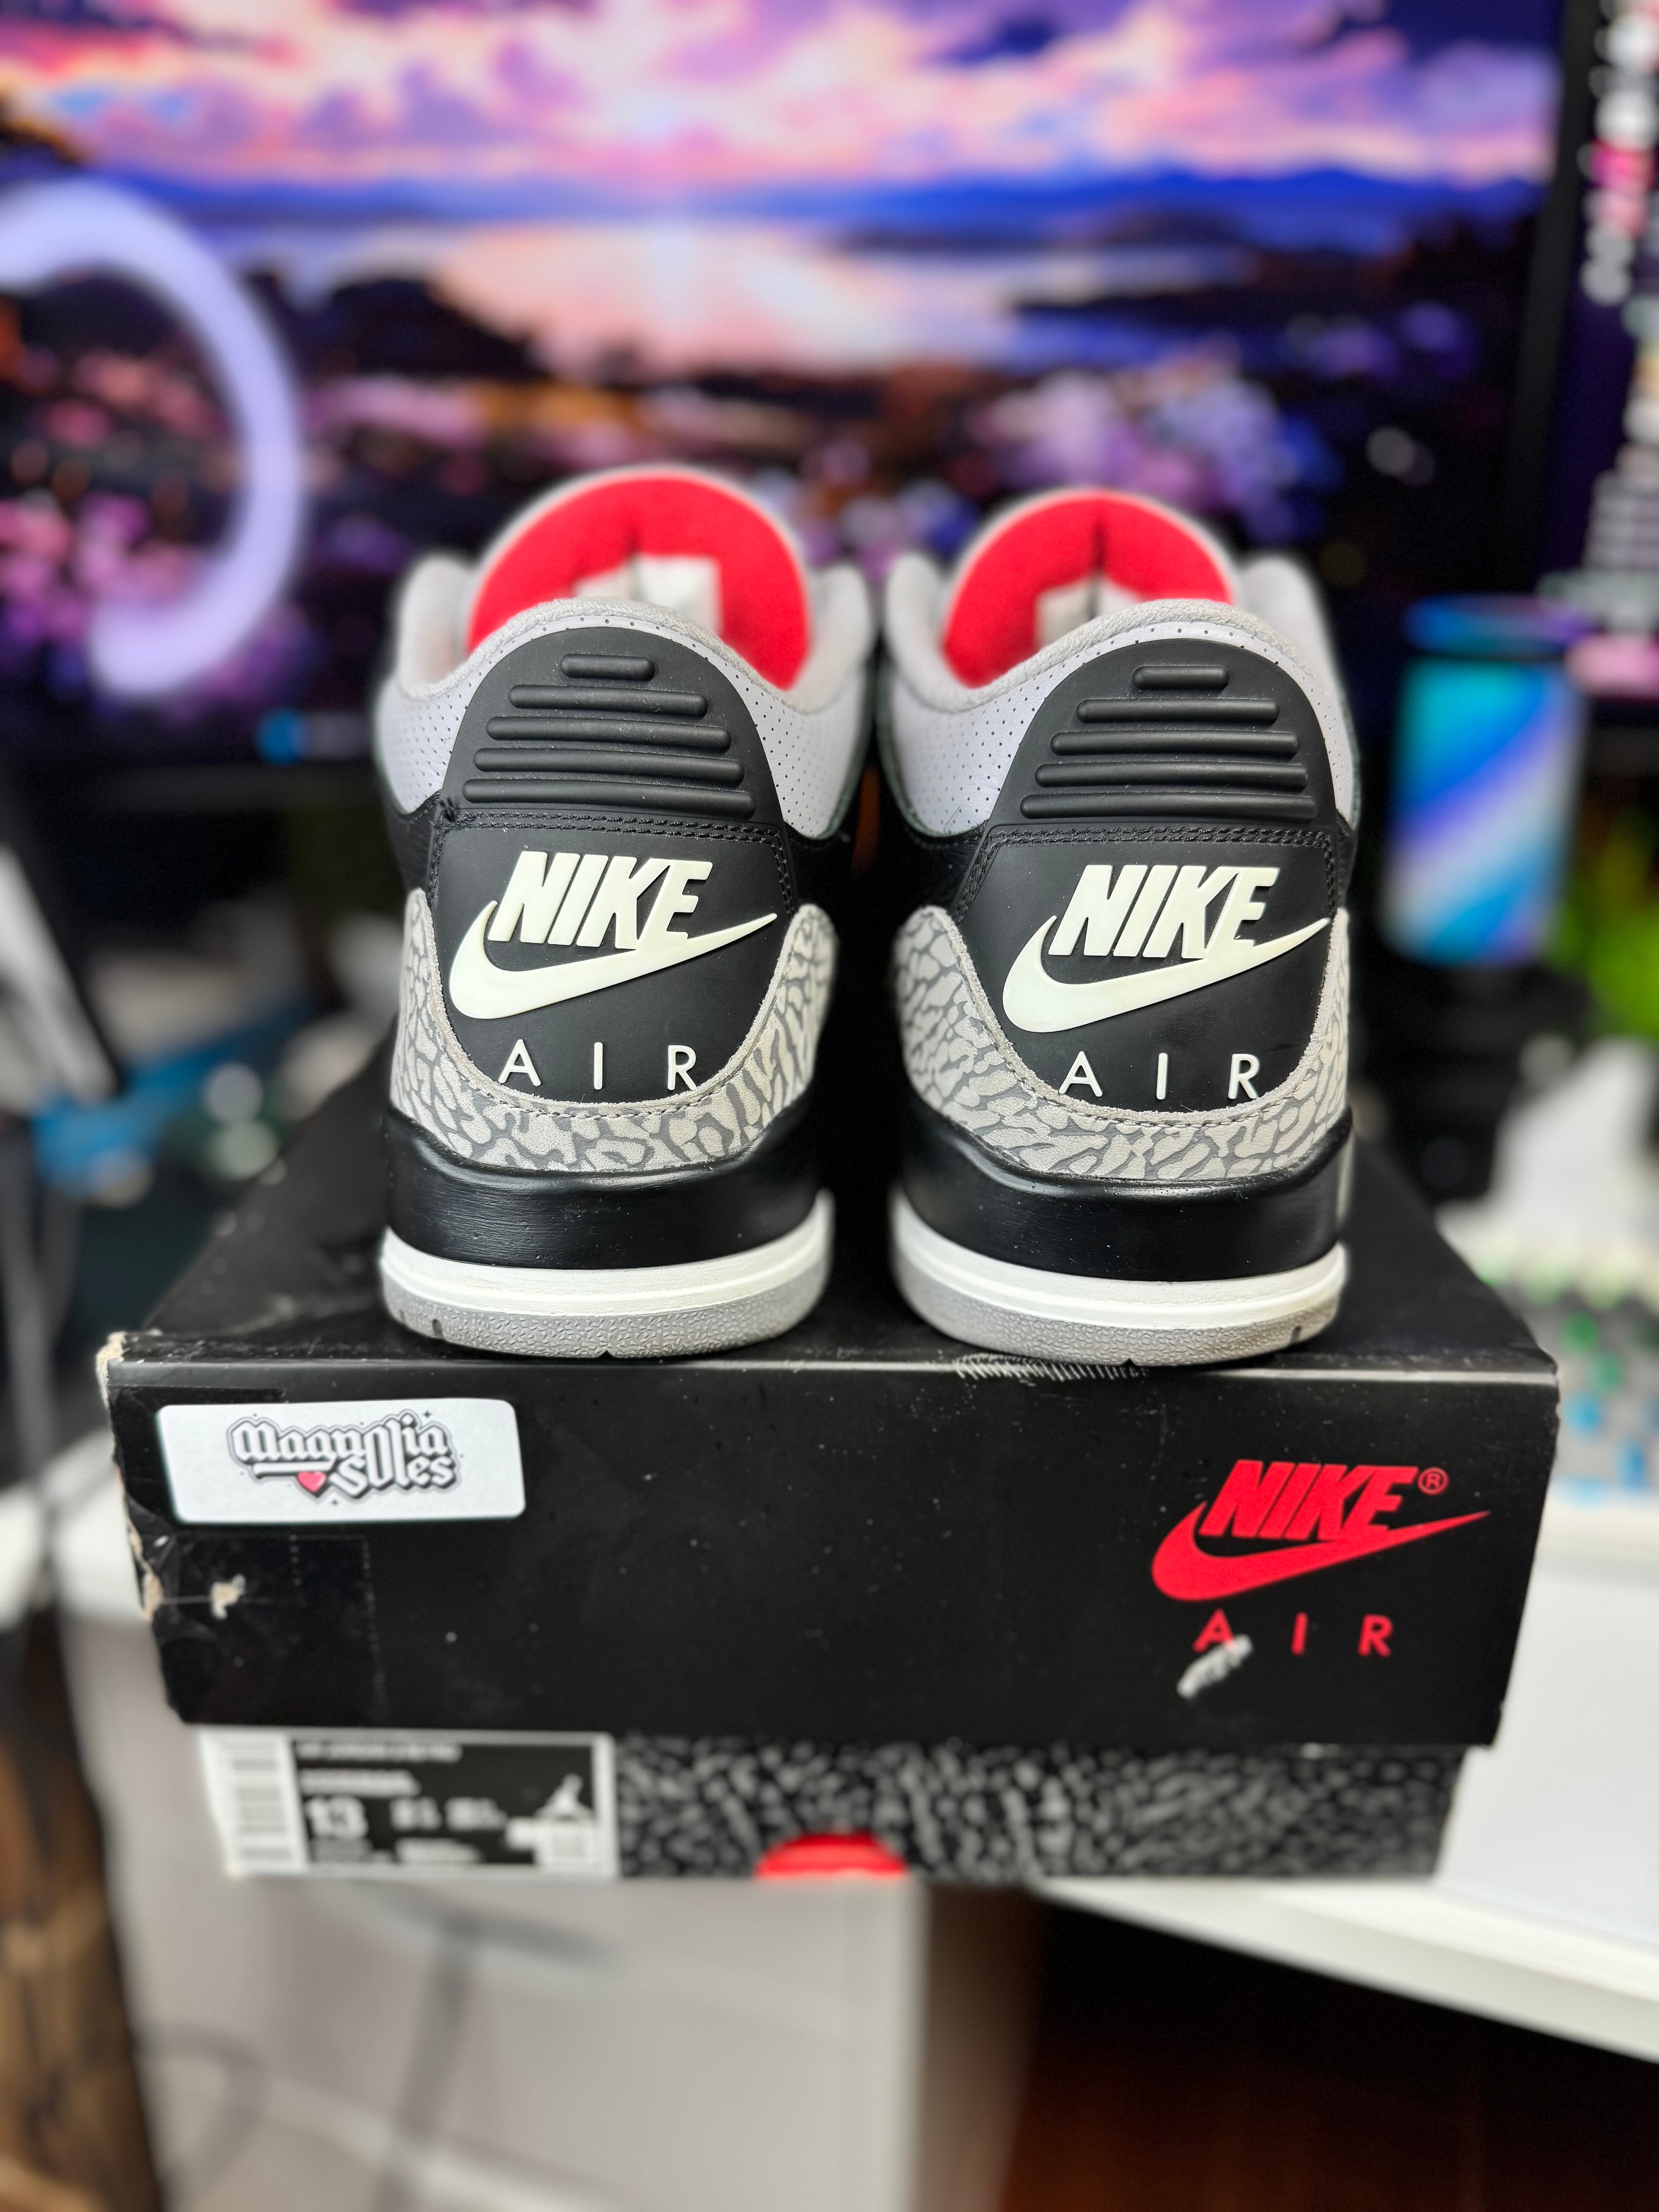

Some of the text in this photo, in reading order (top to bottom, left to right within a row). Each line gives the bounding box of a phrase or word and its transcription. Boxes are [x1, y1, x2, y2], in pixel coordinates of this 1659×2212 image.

[488, 850, 713, 950] NIKE
[1048, 865, 1280, 958] NIKE
[498, 1039, 697, 1091] AIR
[1058, 1051, 1260, 1100] AIR
[1193, 1608, 1394, 1657] AIR
